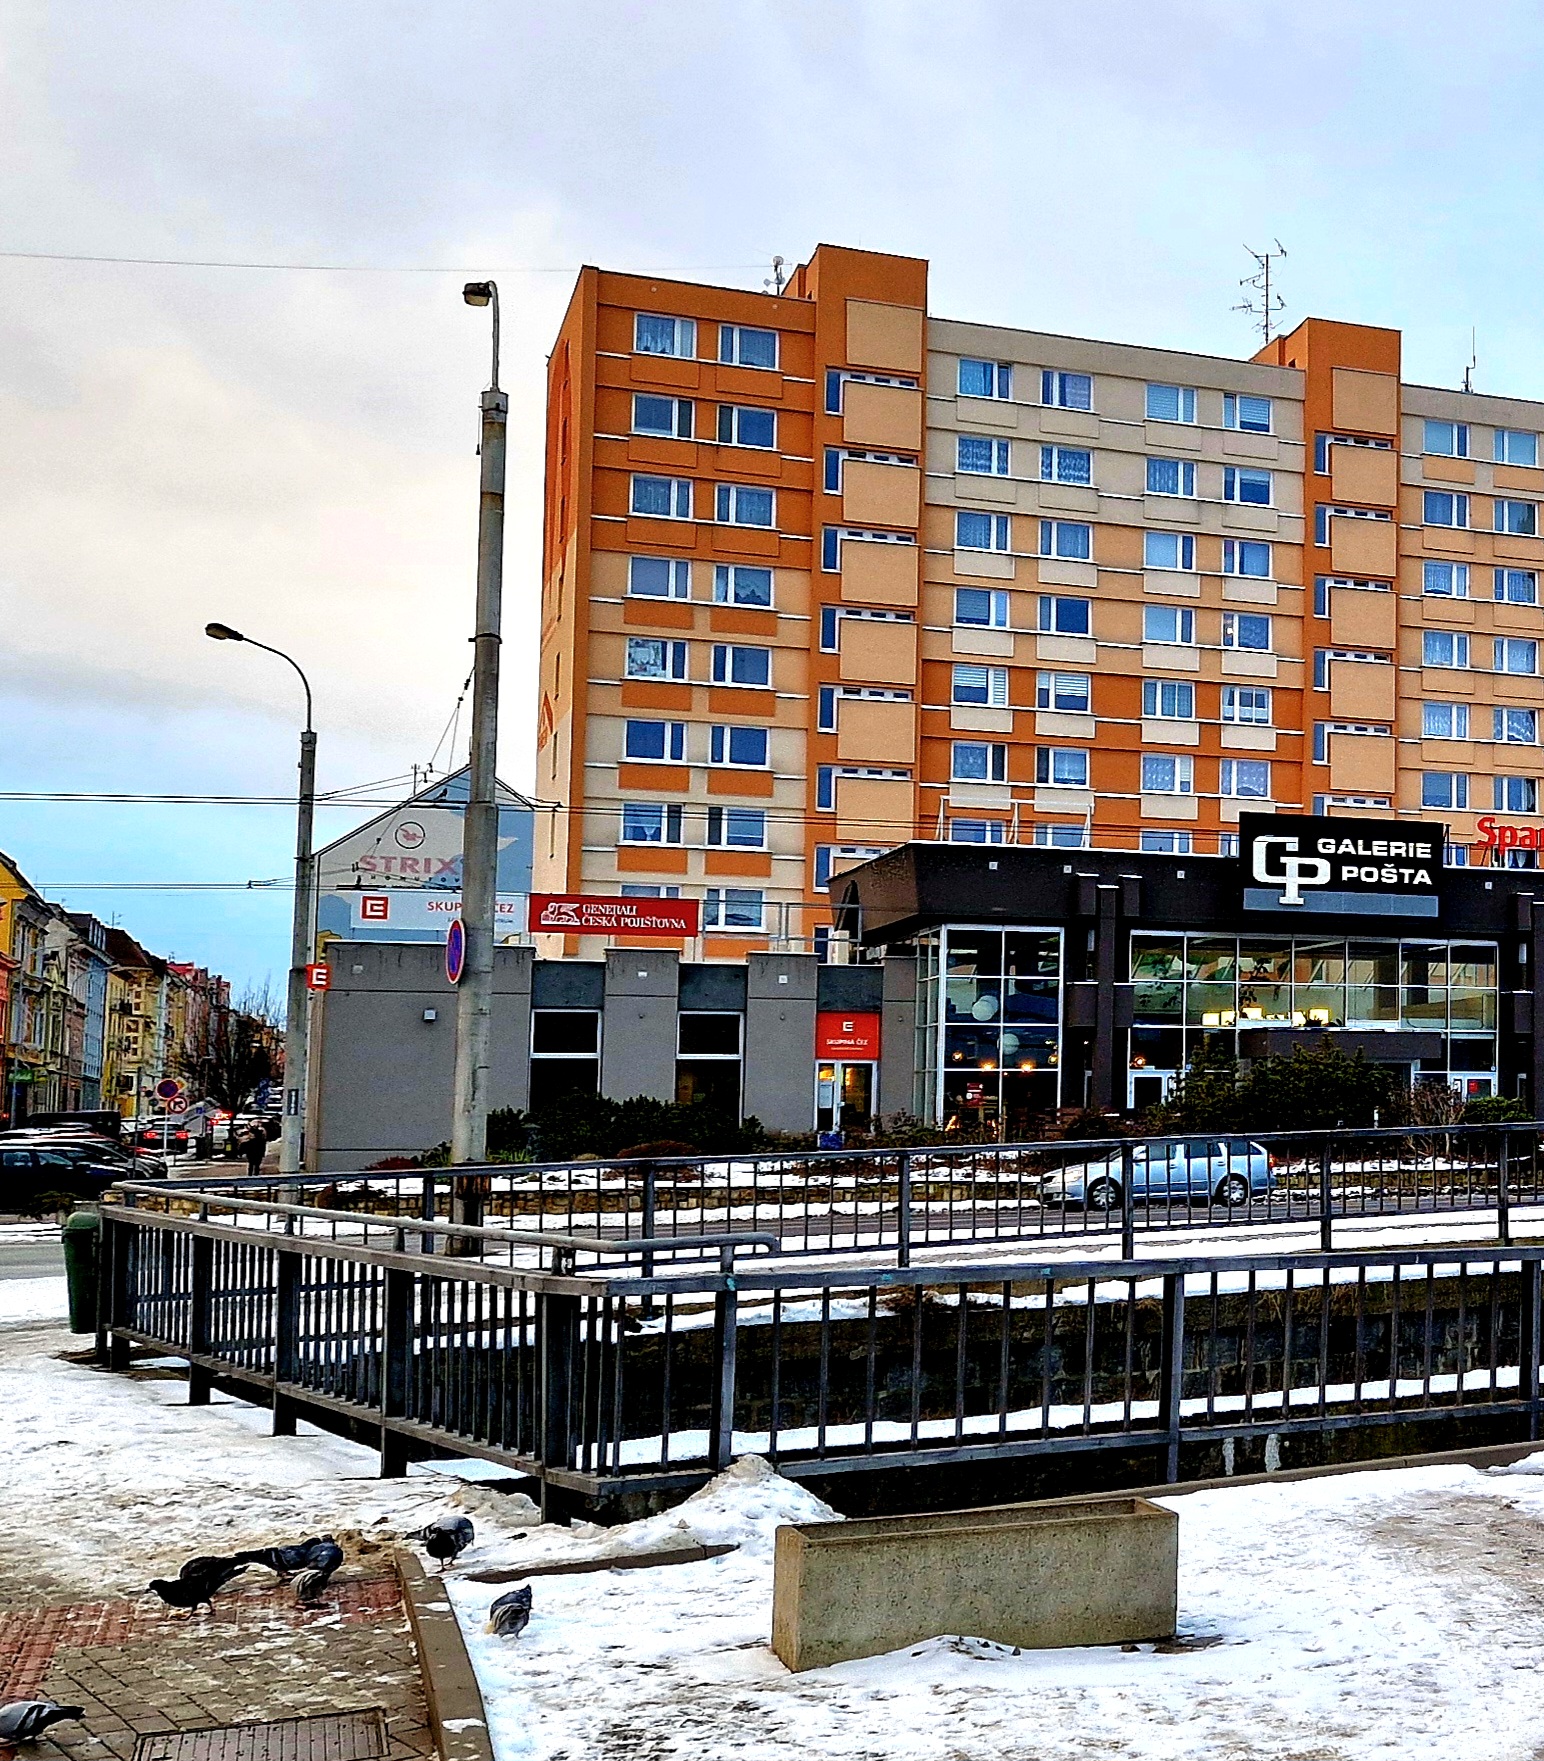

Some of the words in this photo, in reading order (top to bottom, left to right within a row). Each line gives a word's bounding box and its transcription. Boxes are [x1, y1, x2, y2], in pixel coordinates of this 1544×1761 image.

[1317, 838, 1432, 858] GALERIE
[359, 855, 457, 875] STRIX
[1341, 863, 1433, 885] POŠTA
[582, 904, 636, 915] GENERALI
[581, 914, 618, 926] ČESKÁ
